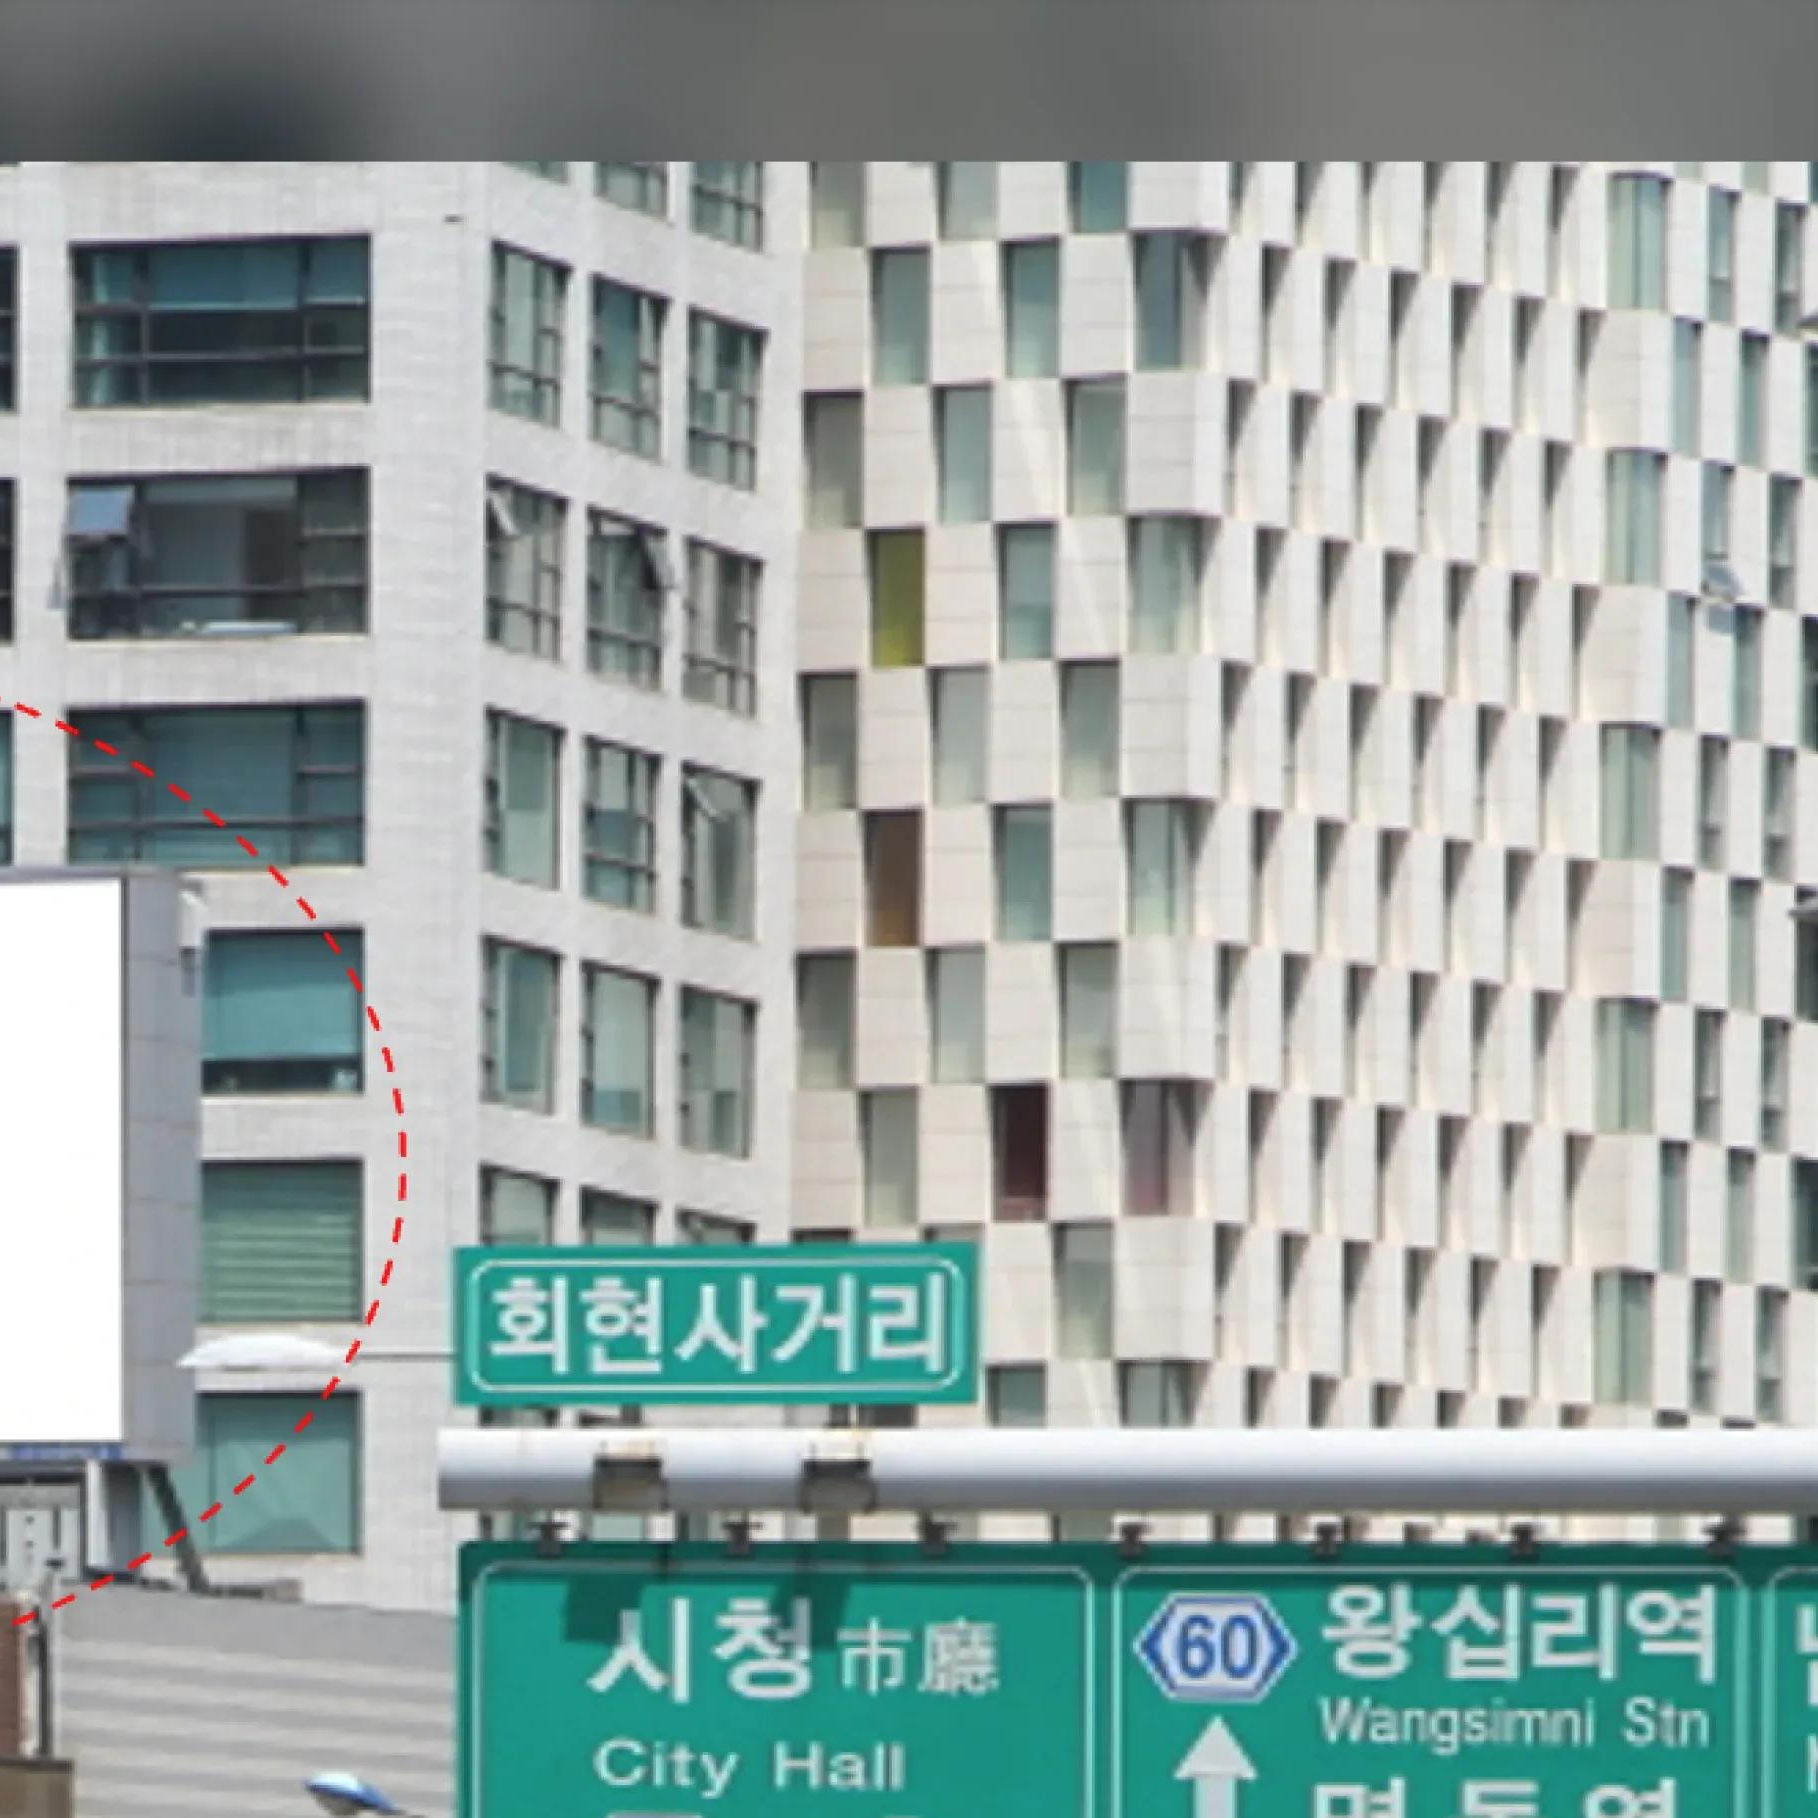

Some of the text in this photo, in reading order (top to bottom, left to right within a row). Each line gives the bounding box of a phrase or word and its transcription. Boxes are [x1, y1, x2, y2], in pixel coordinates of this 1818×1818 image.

[489, 1273, 948, 1375] 회현사거리
[586, 1597, 813, 1703] 시청
[1177, 1613, 1260, 1680] 60
[1320, 1582, 1717, 1685] 왕십리역
[592, 1736, 905, 1800] City Hall
[1318, 1696, 1710, 1756] Wangsimni Stn
